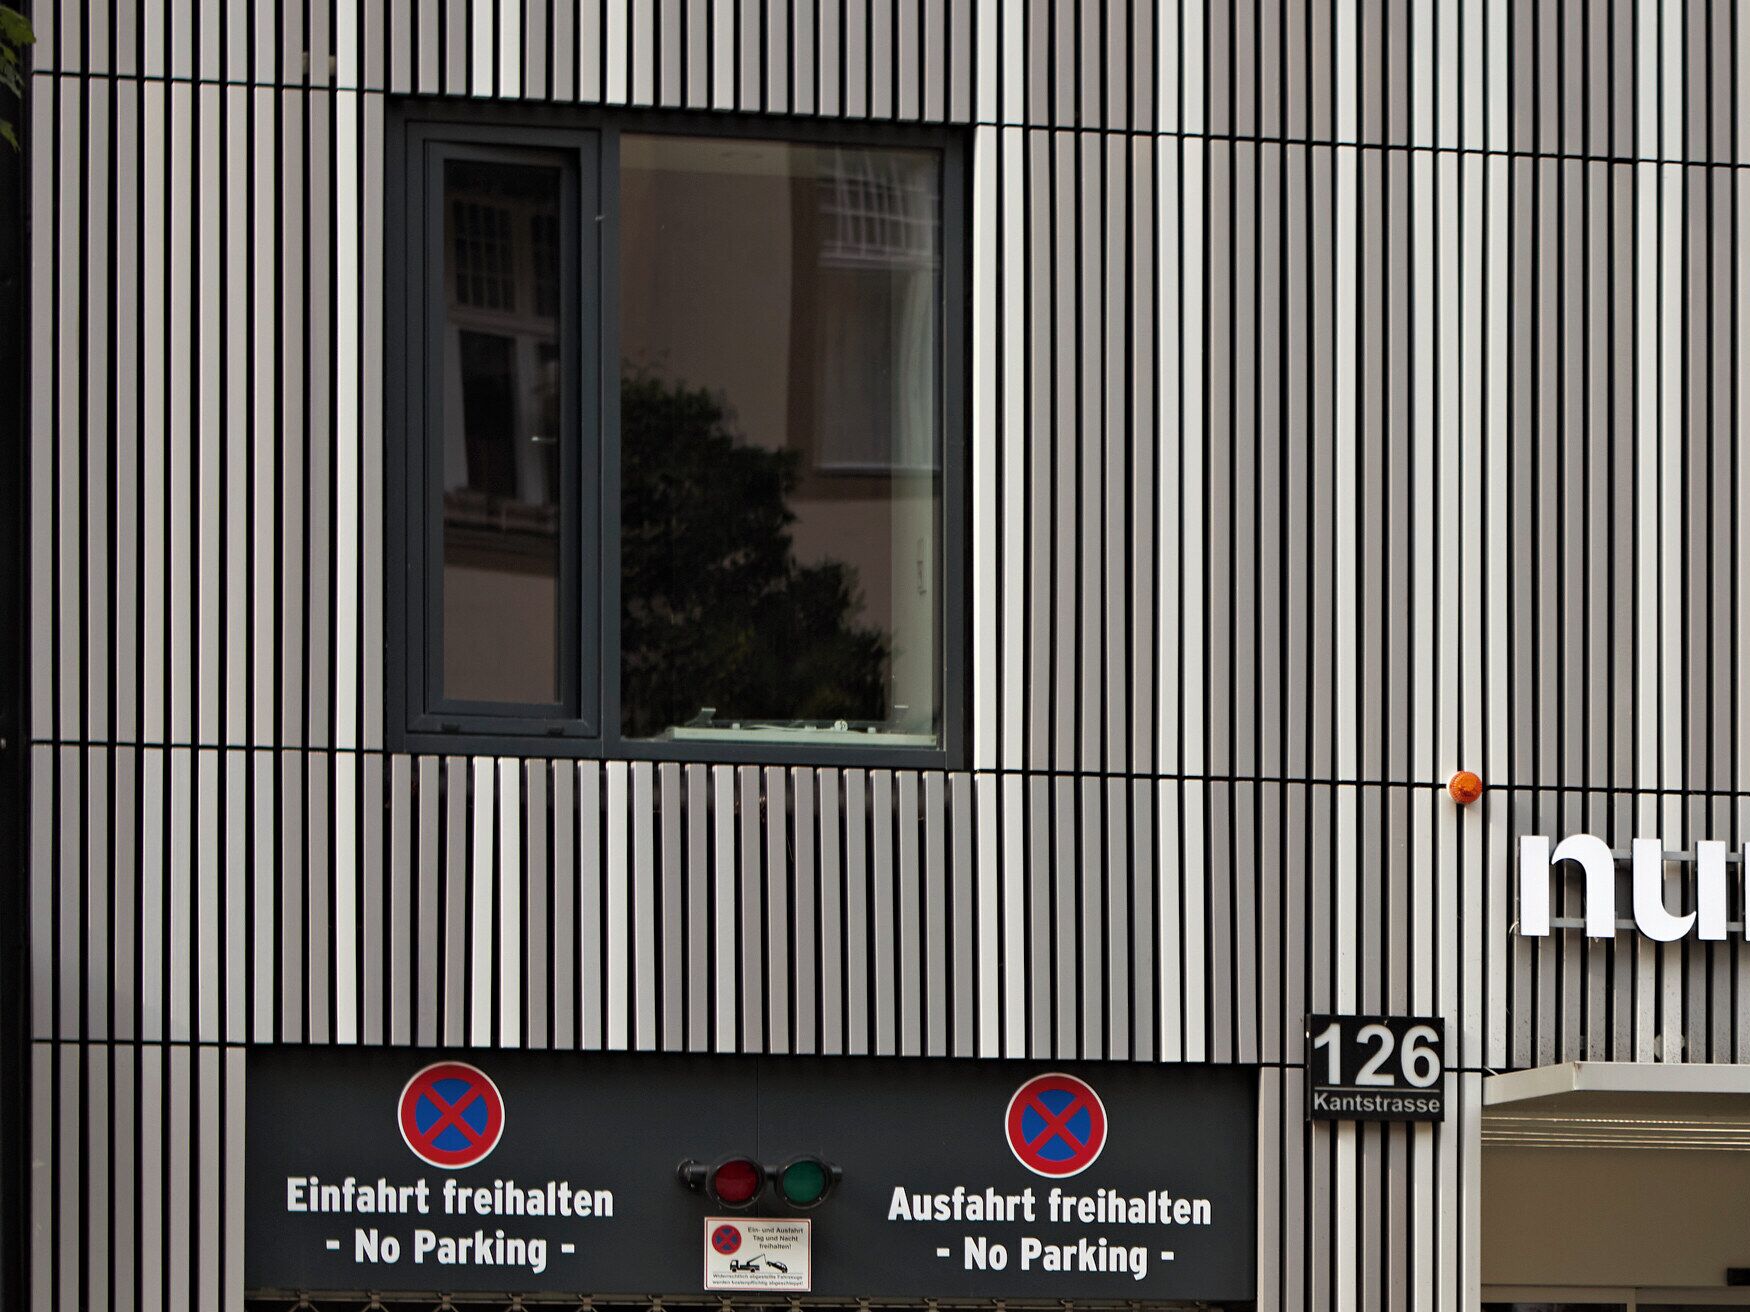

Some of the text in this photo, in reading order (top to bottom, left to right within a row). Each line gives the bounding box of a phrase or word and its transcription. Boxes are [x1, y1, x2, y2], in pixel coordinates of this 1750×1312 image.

[1314, 1022, 1441, 1088] 126
[1314, 1091, 1441, 1114] Kantstrasse
[287, 1176, 615, 1218] Einfahrt freihalten
[888, 1185, 1212, 1226] Ausfahrt freihalten
[355, 1228, 401, 1264] No
[414, 1229, 547, 1274] Parking
[964, 1236, 1008, 1271] No
[1021, 1237, 1148, 1281] Parking
